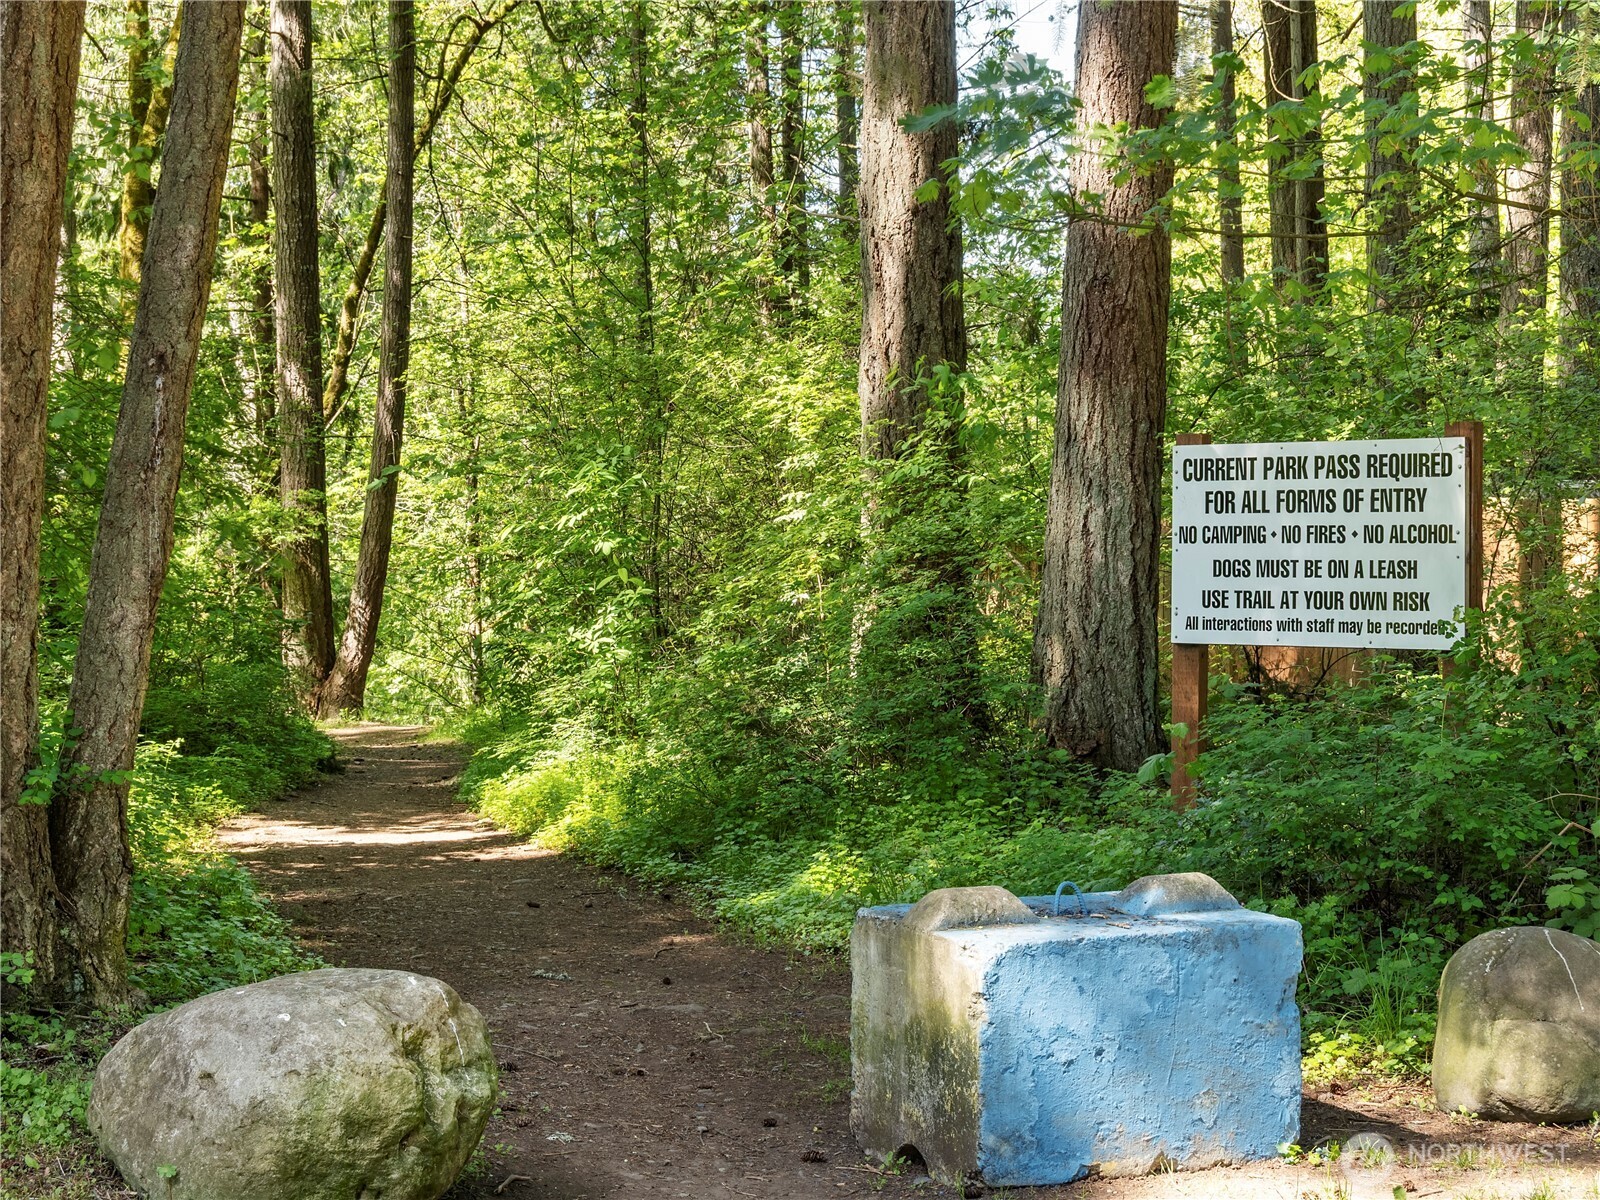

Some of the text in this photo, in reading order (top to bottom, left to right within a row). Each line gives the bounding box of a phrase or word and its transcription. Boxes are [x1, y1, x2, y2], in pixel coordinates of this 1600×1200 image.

[1183, 453, 1452, 482] CURRENT PARK PASS REQUIRED
[1205, 488, 1427, 514] FOR ALL FORMS OF ENTRY
[1179, 524, 1456, 544] NO CAMPING NO FIRES NO ALCOHOL
[1213, 559, 1418, 579] DOGS MUST BE ON A LEASH
[1202, 590, 1430, 611] USE TRAIL AT YOUR OWN RISK
[1185, 616, 1198, 631] All
[1202, 617, 1272, 631] interactions
[1277, 617, 1302, 632] with
[1307, 618, 1334, 633] staff
[1339, 621, 1362, 636] may
[1367, 620, 1381, 634] be
